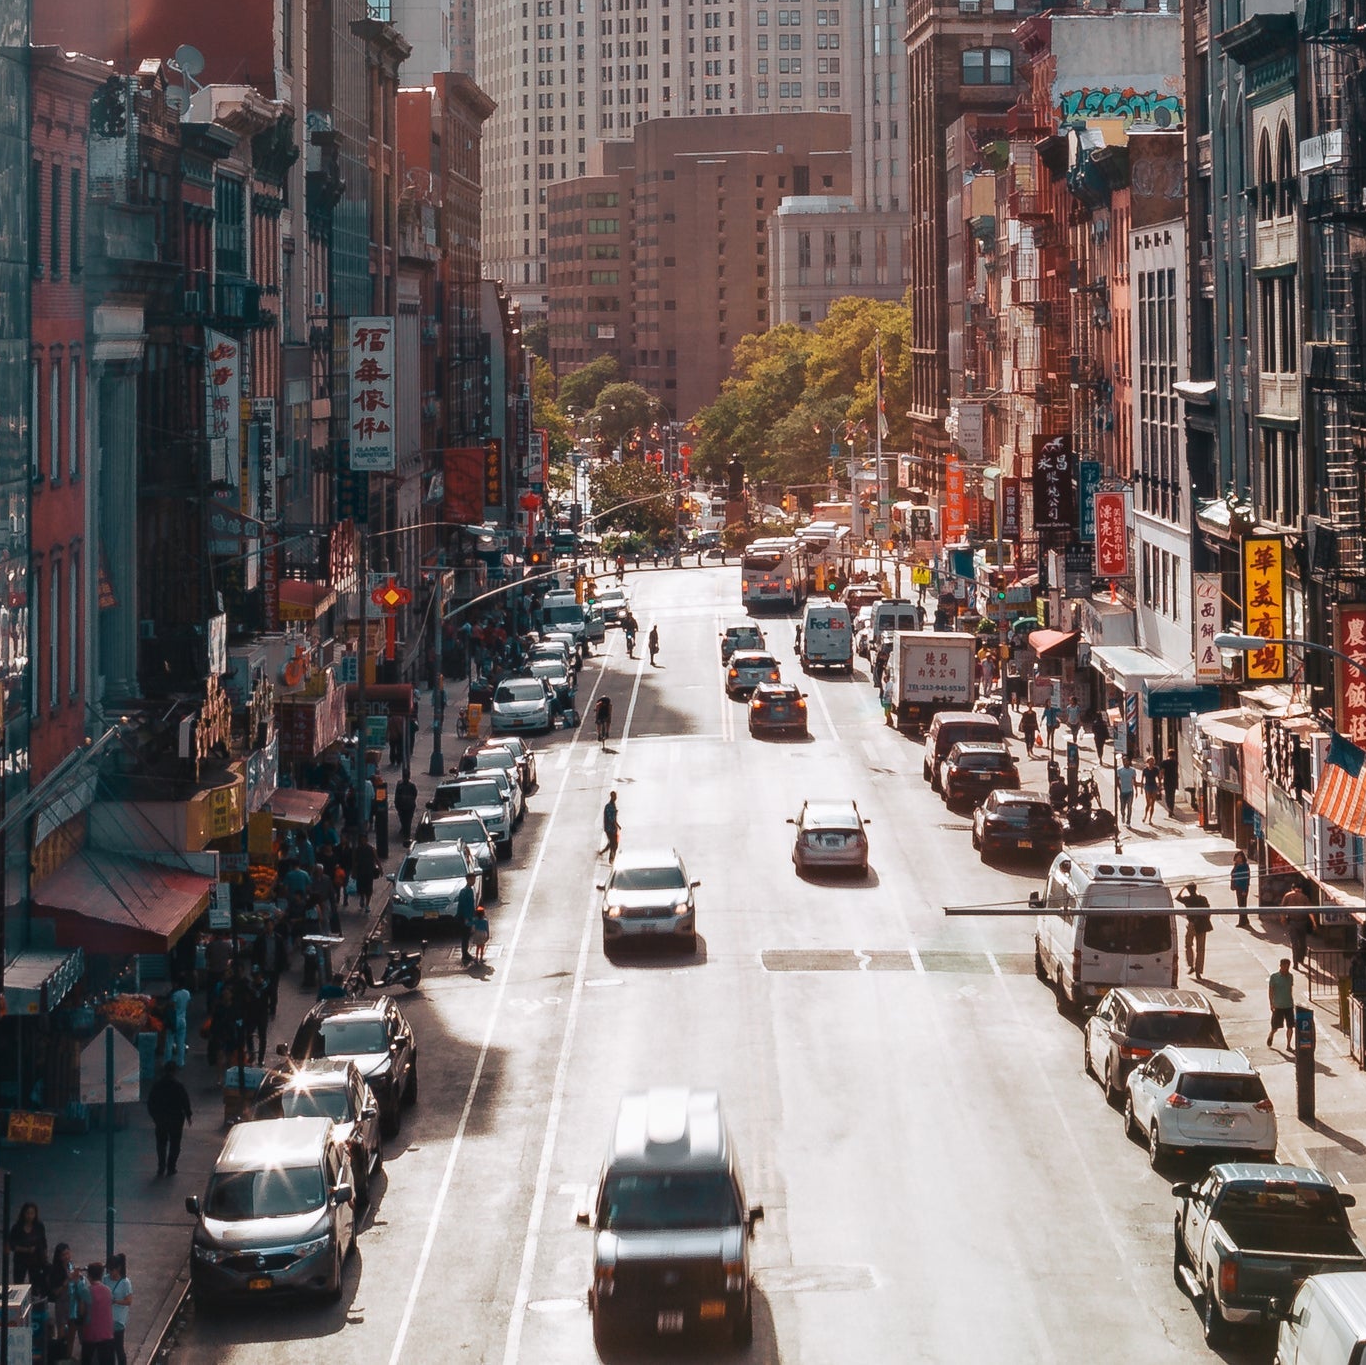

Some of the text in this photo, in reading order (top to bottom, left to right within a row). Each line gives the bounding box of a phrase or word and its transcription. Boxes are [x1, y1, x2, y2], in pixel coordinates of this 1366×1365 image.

[352, 327, 391, 441] 福華傢俬
[810, 618, 845, 630] FedEx
[1250, 545, 1281, 674] 華美商場
